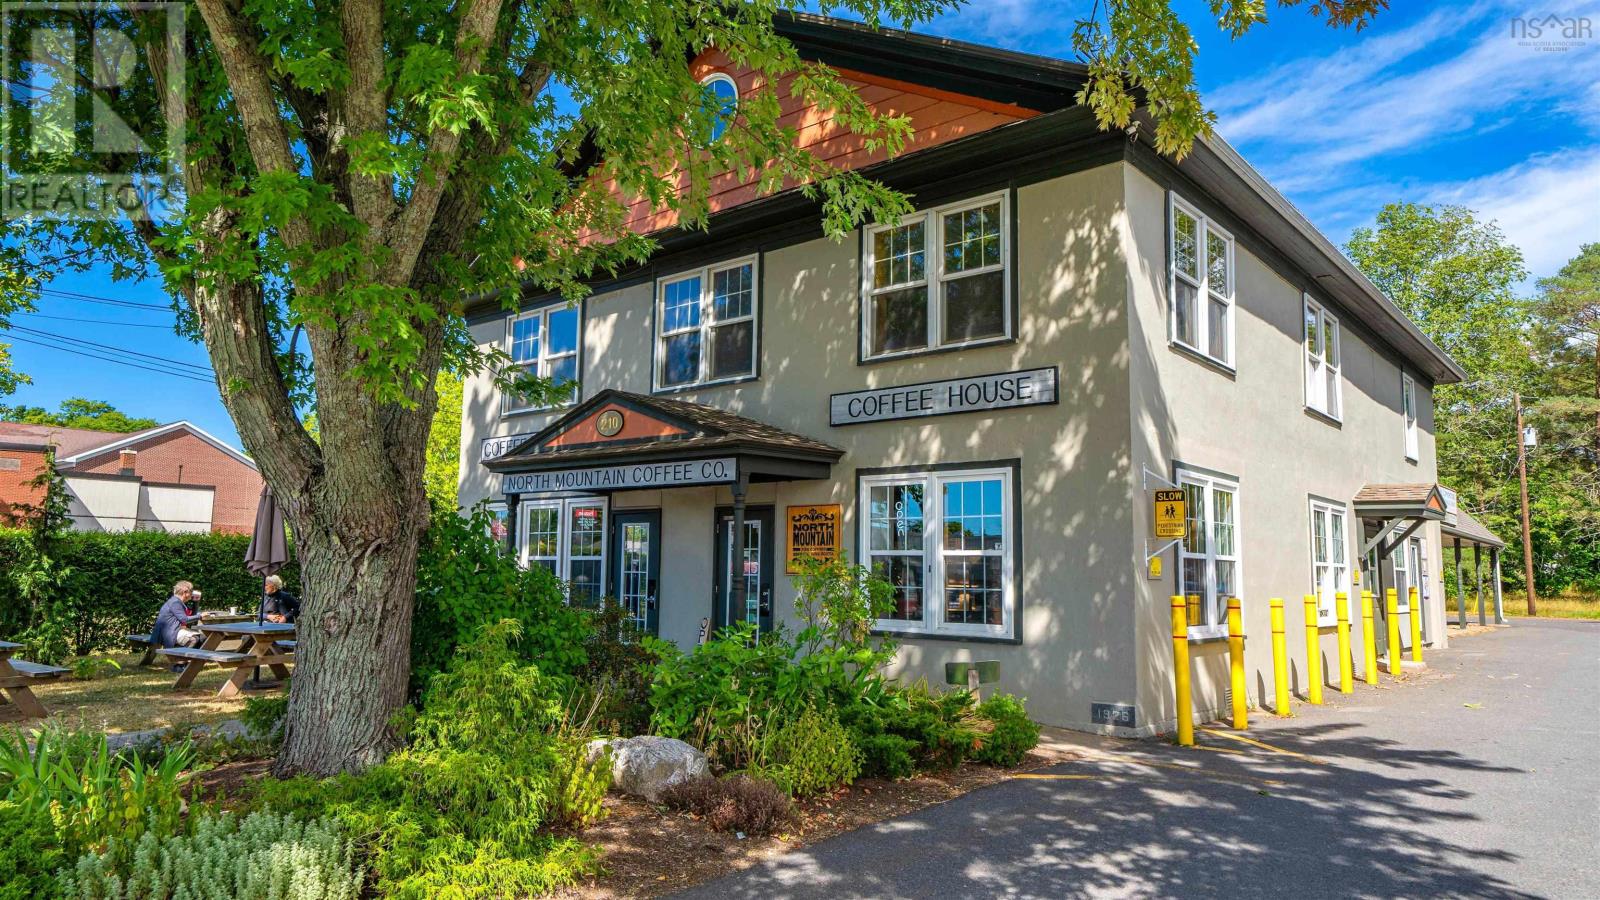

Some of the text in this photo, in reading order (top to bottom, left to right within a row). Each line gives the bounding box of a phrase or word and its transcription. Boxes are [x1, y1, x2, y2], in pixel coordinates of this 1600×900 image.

[848, 376, 1032, 418] COFFEE HOUSE
[600, 416, 618, 431] 210
[484, 437, 528, 457] COFF
[508, 461, 729, 491] NORTH MOUNTAIN COFFEE CO.
[1157, 491, 1183, 501] SLOW
[793, 523, 834, 531] NORTH
[793, 531, 834, 547] MOUNTAIN
